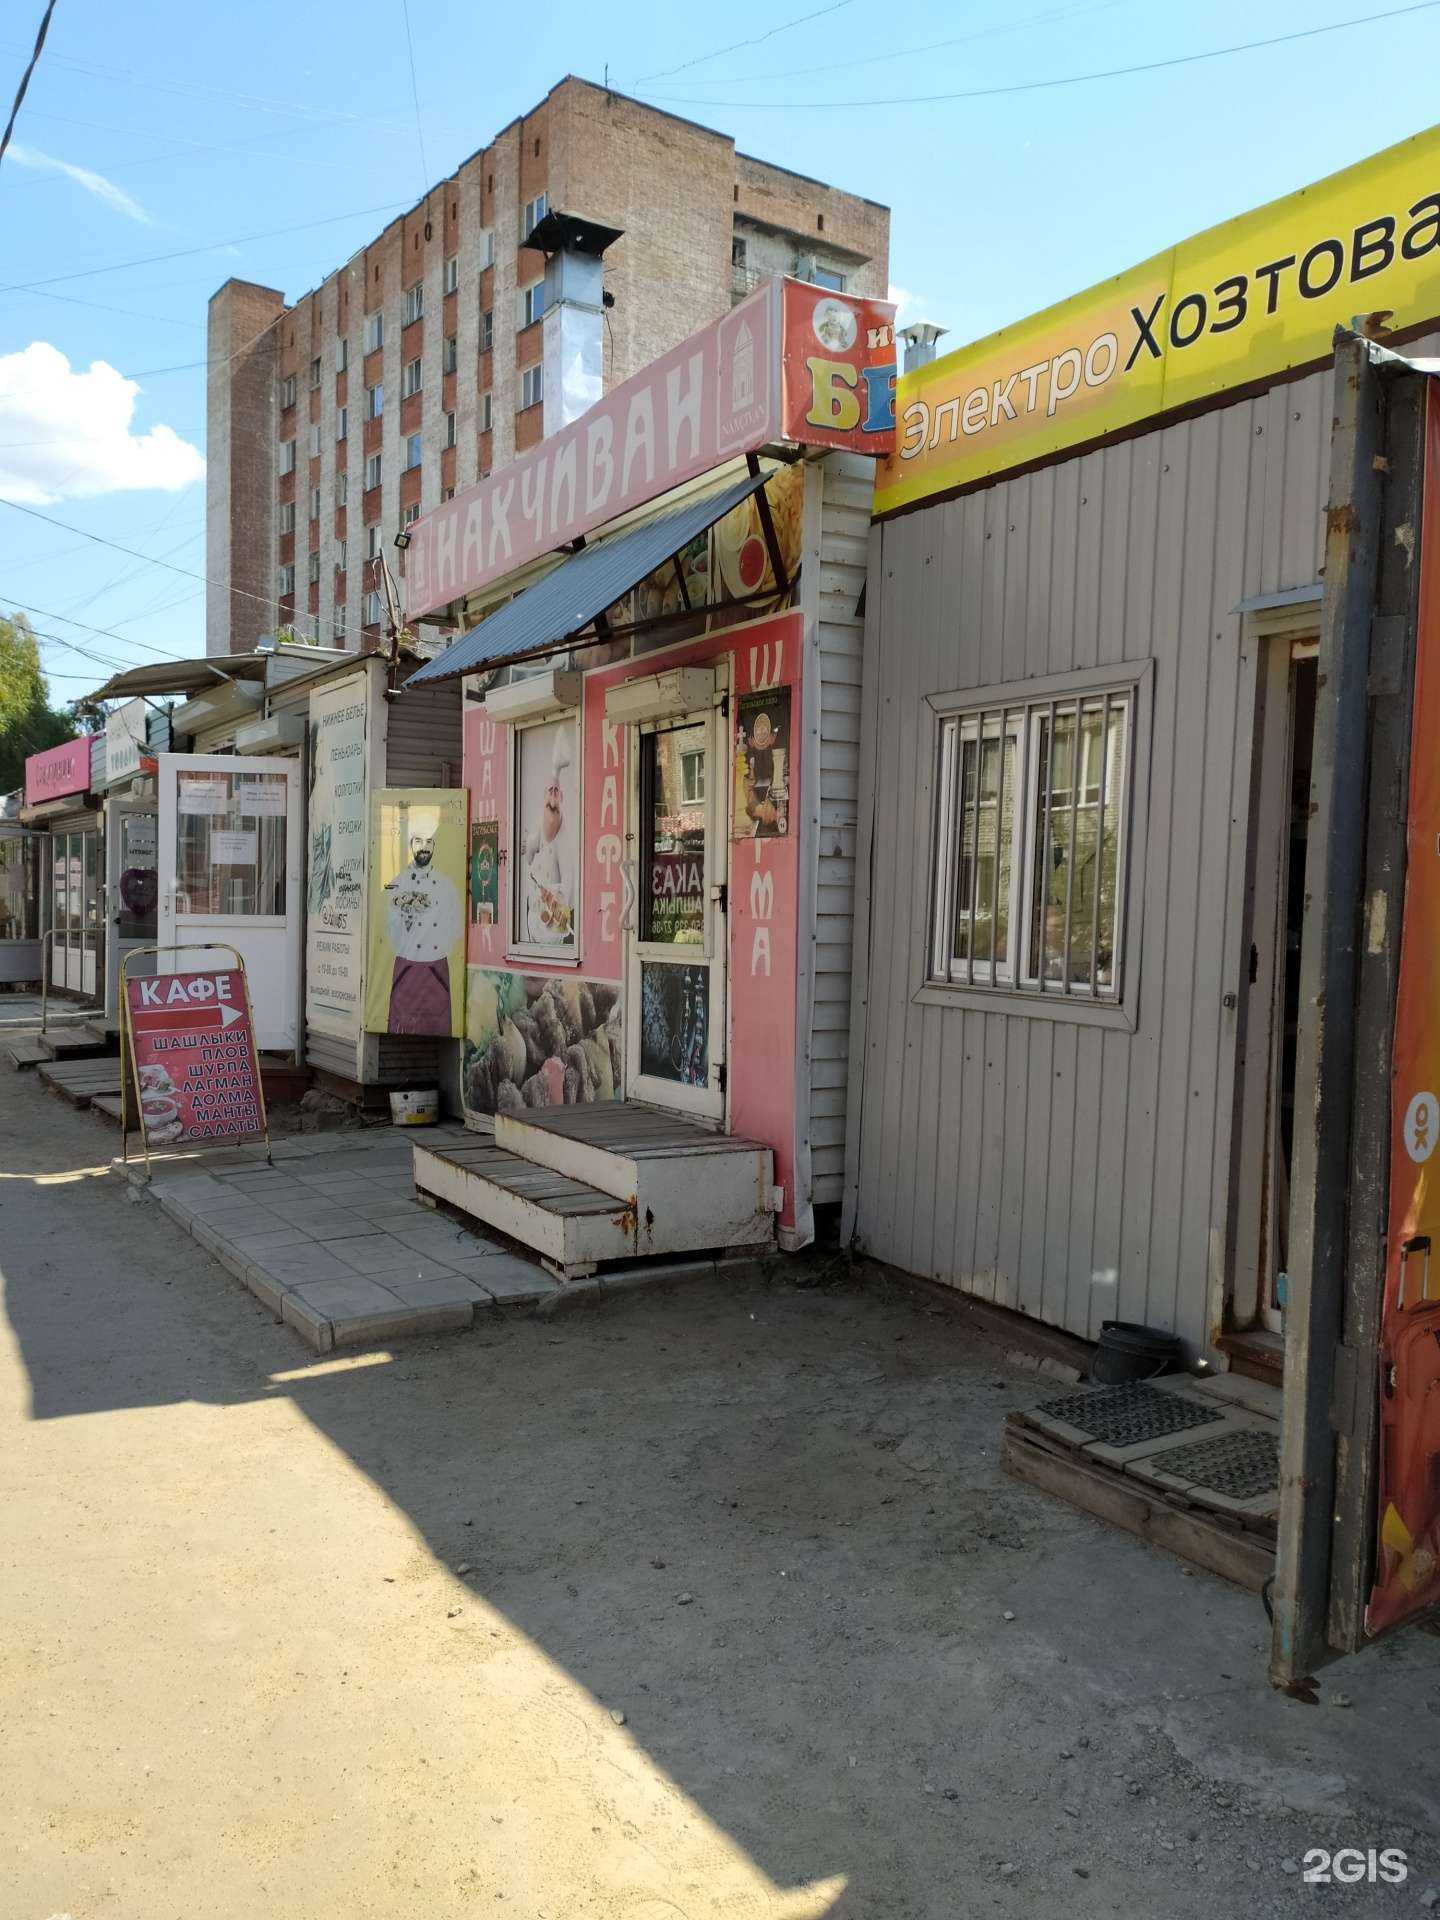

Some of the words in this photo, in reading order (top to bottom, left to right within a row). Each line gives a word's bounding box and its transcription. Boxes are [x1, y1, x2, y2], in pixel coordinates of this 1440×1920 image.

[140, 975, 232, 1006] КАФЕ
[153, 1030, 247, 1050] ШАШЛЫКИ
[201, 1045, 249, 1062] ПЛОВ
[188, 1060, 251, 1078] ШУРПА
[183, 1075, 254, 1093] ЛАГМАН
[191, 1091, 256, 1109] ДОЛМА
[196, 1104, 257, 1122] МАНТЫ
[188, 1118, 260, 1139] САЛАТЫ
